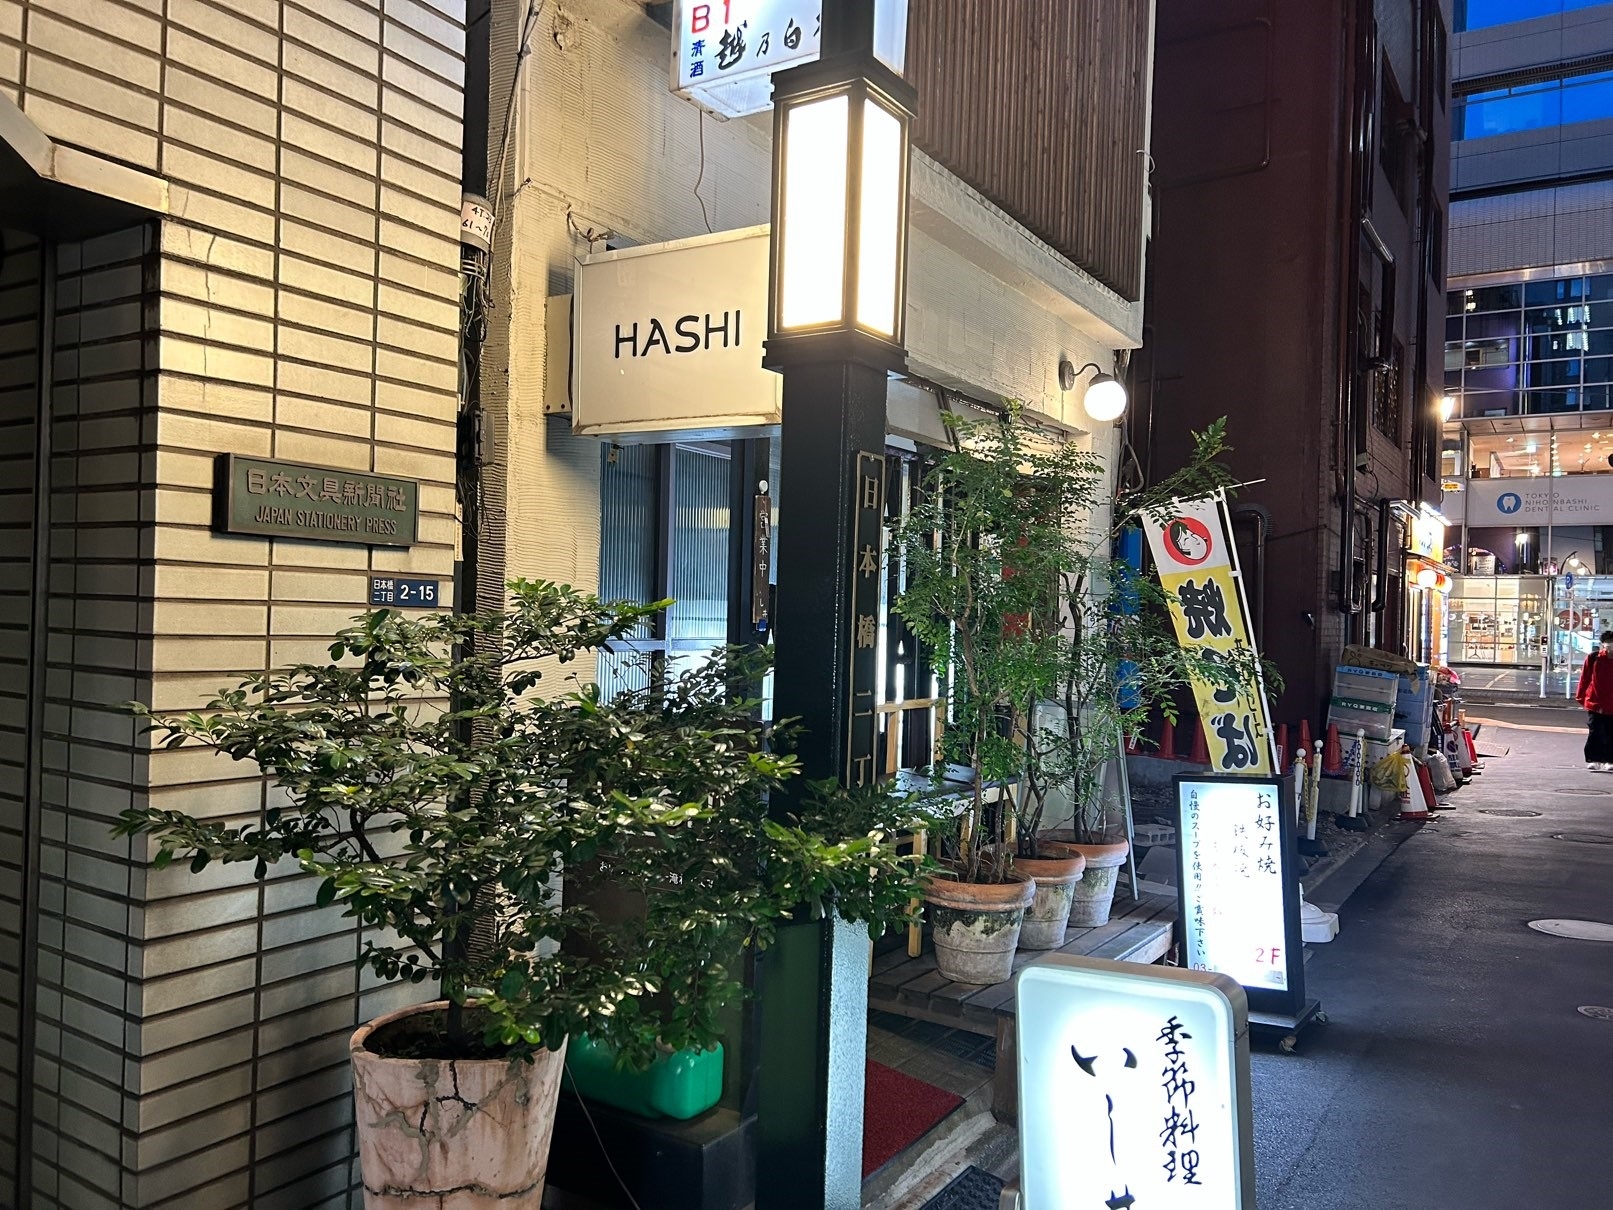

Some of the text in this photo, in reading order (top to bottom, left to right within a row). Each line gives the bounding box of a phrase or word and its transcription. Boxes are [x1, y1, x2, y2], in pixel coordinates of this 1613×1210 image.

[714, 14, 820, 71] 越乃白
[689, 39, 707, 79] 清酒
[614, 309, 742, 359] HASHI
[246, 467, 407, 512] 日本文具新聞社
[1525, 492, 1560, 500] TOKYO
[1525, 498, 1588, 506] NIHONBASHI
[1525, 505, 1564, 513] DENTAL
[254, 505, 397, 535] JAPAN STATIONERY PRESS
[373, 579, 394, 590] 日本橋
[373, 591, 394, 602] 二丁目
[399, 584, 434, 601] 2-15
[1255, 792, 1277, 875] お好み焼
[1255, 947, 1281, 965] 2F
[1155, 1015, 1203, 1186] 季節料理
